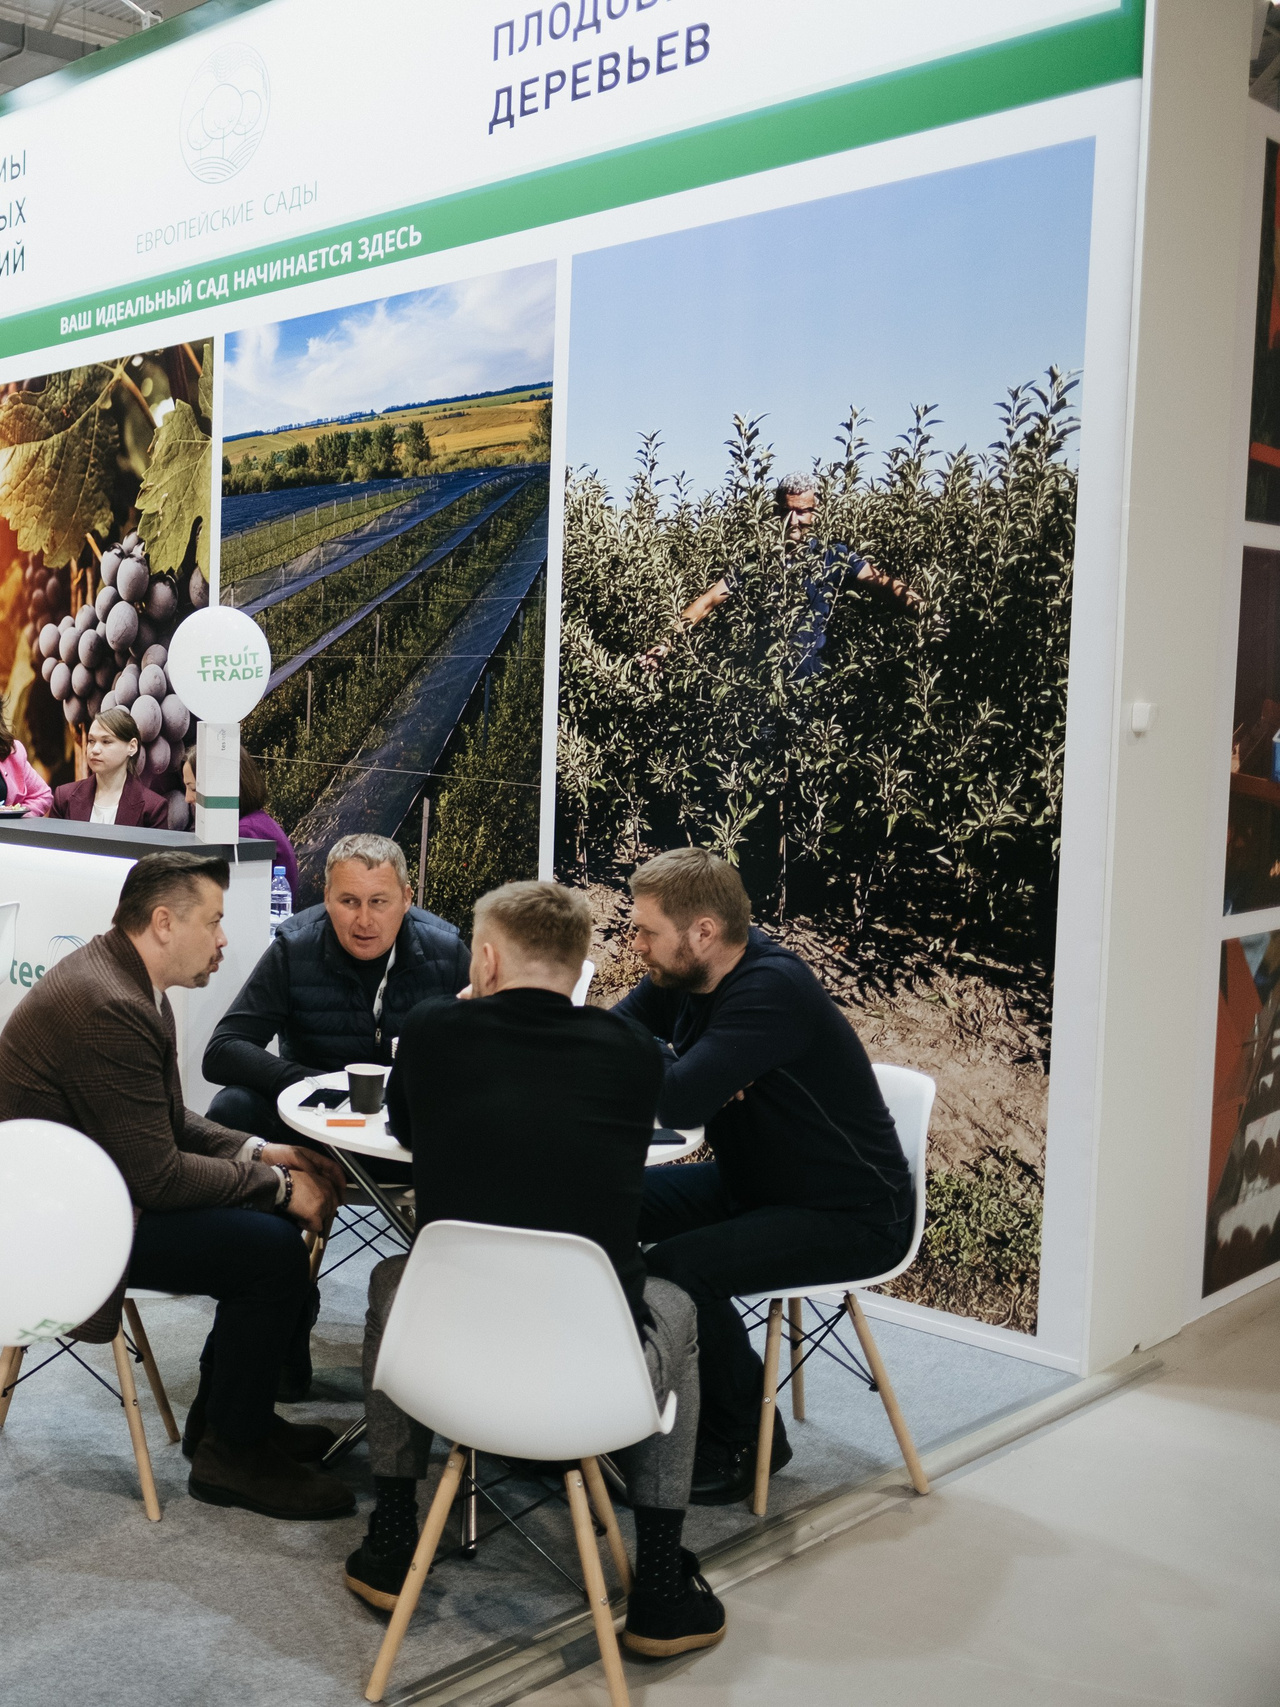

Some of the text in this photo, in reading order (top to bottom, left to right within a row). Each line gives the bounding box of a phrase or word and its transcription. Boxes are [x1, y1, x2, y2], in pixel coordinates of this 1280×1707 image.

[493, 0, 665, 61] ПЛОДО
[489, 22, 711, 135] ДЕРЕВЬЕВ
[136, 181, 318, 254] ЕВРОПЕЙСКИЕ САДЫ
[60, 225, 422, 335] ВАШ ИДЕАЛЬНЫЙ САД НАЧИНАЕТСЯ ЗДЕСЬ
[197, 666, 264, 682] TRADE
[200, 650, 260, 668] FRUIT
